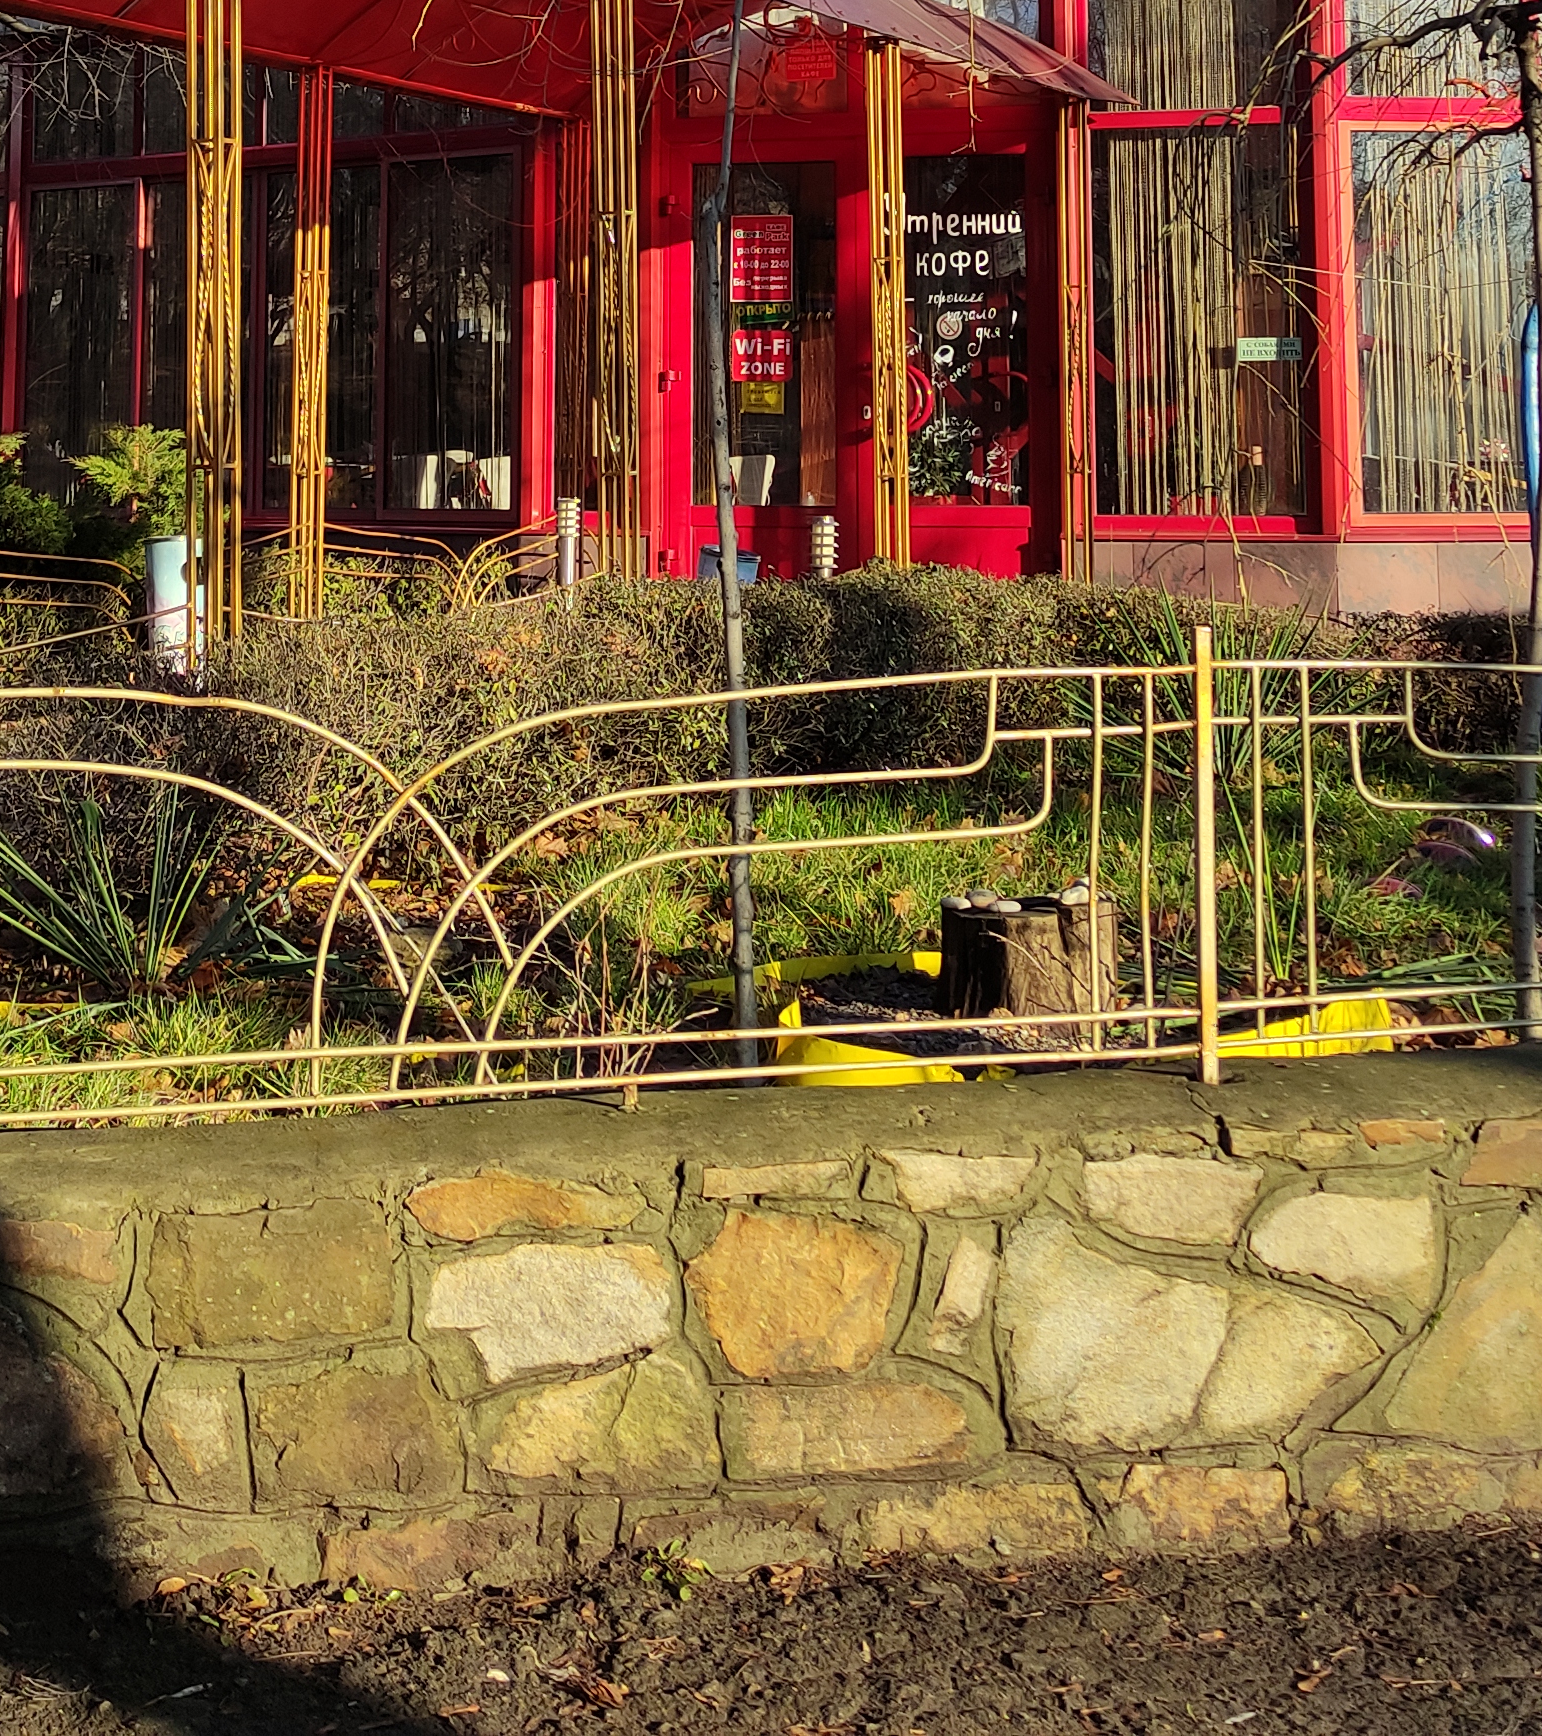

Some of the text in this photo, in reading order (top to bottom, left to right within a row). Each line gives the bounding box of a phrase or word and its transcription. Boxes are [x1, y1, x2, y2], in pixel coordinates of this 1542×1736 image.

[734, 228, 789, 241] Green Park
[736, 246, 787, 256] работает
[760, 261, 769, 269] до
[733, 277, 751, 287] Без
[736, 302, 792, 317] ОТКРЫТО
[734, 337, 791, 356] Wi-Fi
[1257, 349, 1301, 357] ВХОИТЬ
[740, 361, 785, 375] ZONE
